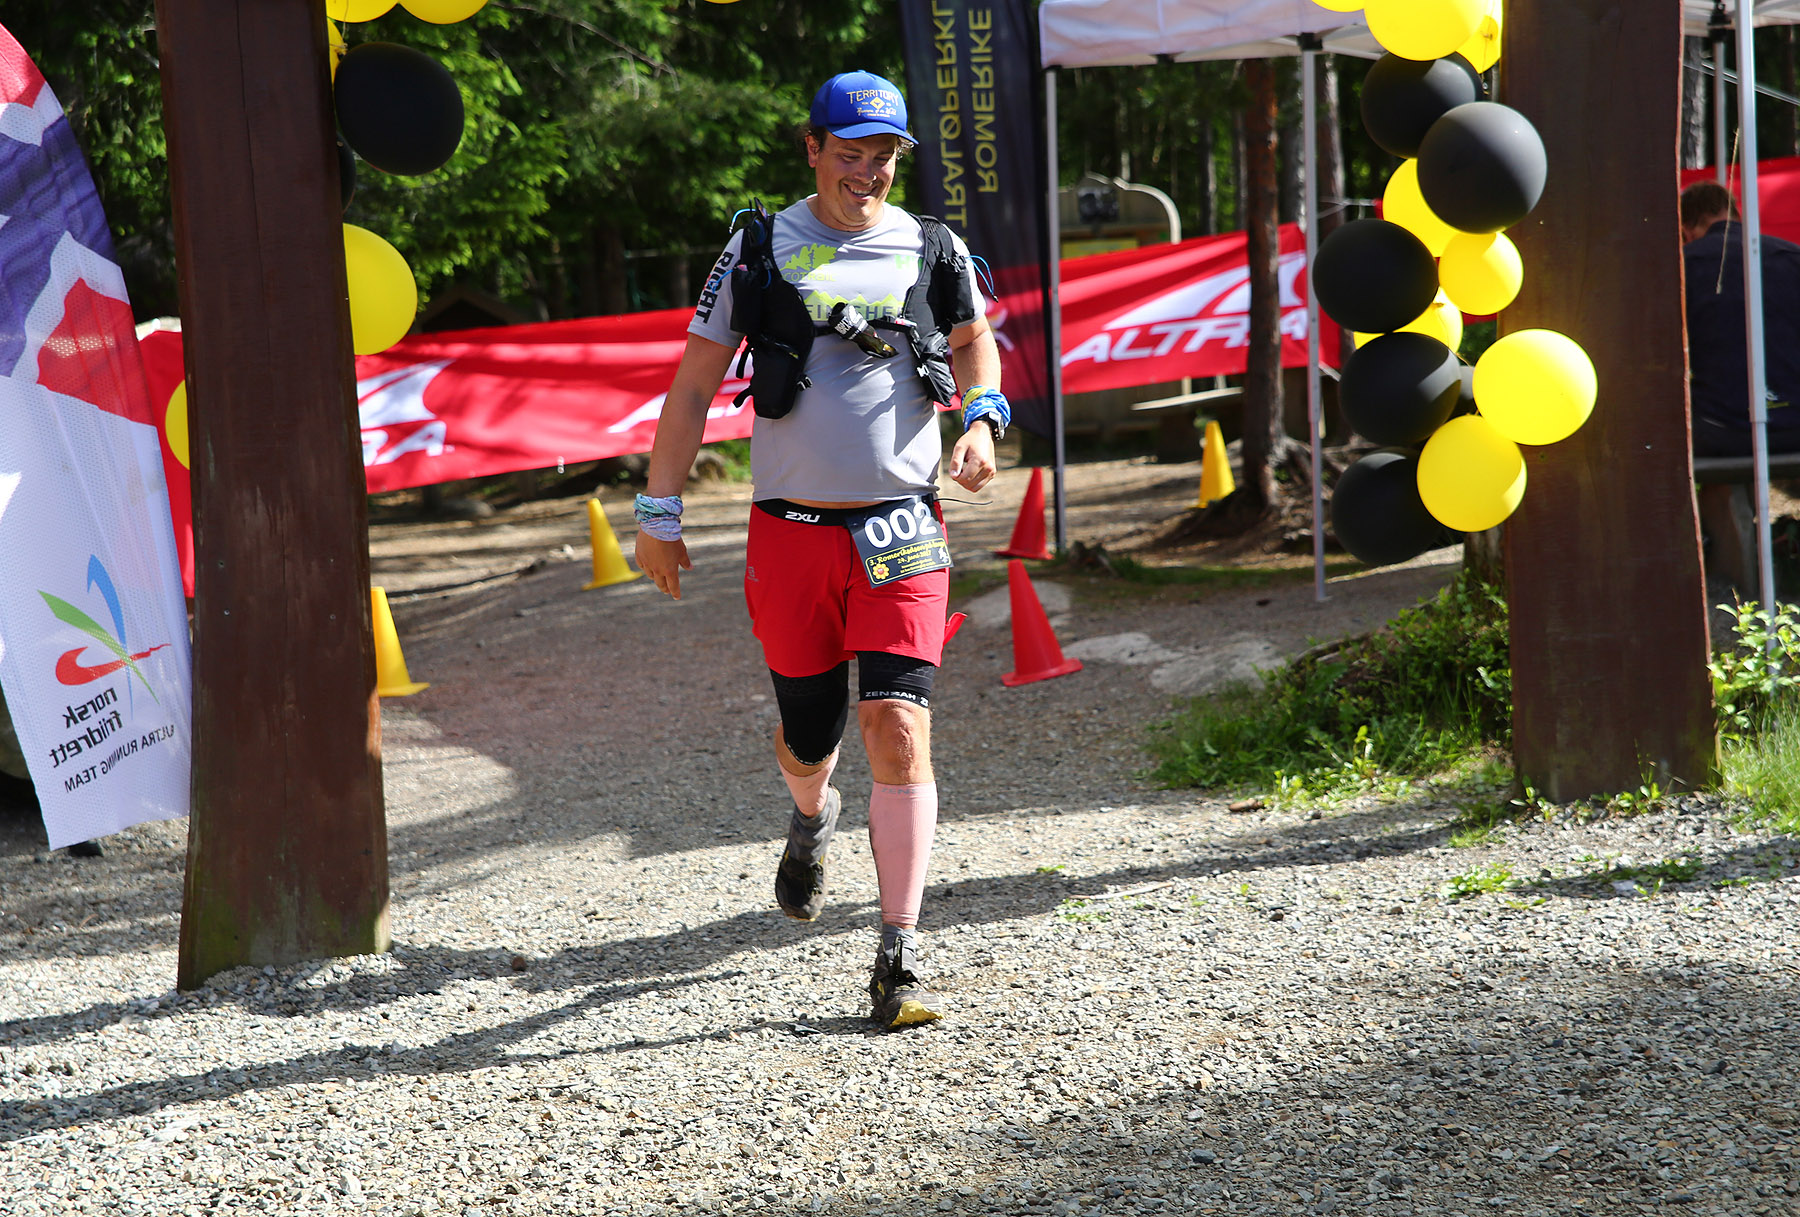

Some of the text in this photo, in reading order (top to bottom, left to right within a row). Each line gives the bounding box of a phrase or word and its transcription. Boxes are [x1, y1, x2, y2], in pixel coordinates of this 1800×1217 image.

[846, 89, 899, 107] TERRITORY
[696, 251, 734, 324] RIGHT
[785, 510, 820, 523] 2XU
[864, 501, 938, 549] 002
